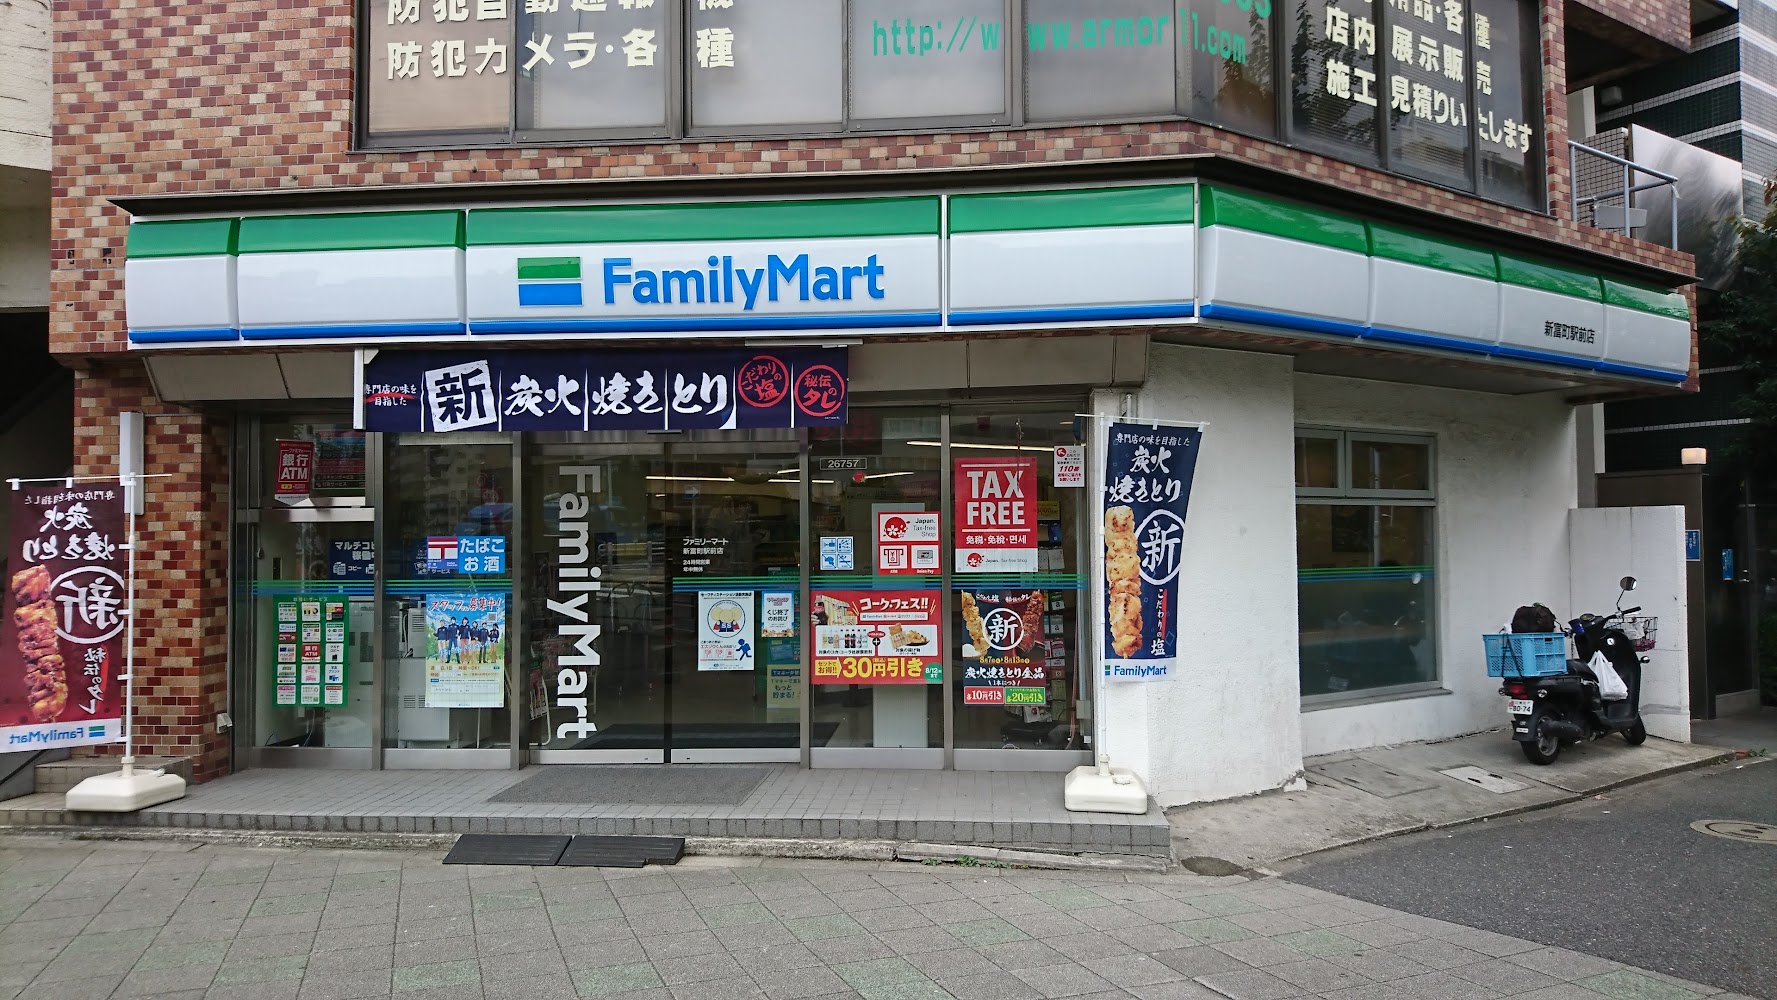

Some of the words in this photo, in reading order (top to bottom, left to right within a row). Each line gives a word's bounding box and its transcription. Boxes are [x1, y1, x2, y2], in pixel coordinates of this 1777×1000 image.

[1325, 7, 1491, 95] 店内展示販売
[603, 254, 884, 310] FamilyMart
[1544, 320, 1595, 344] 新富町駅前店
[374, 396, 407, 406] 目指した
[435, 367, 488, 424] 新
[1115, 432, 1191, 447] 専門店の味を目指した
[282, 453, 309, 466] 銀行
[827, 460, 859, 468] 26757
[1130, 445, 1172, 474] 炭火
[281, 467, 308, 480] ATM
[967, 471, 1024, 498] TAX
[1109, 474, 1182, 503] 焼きとり
[967, 501, 1025, 525] FREE
[460, 538, 505, 553] たばこ
[682, 538, 729, 546] ファミリーマート
[682, 547, 724, 555] 新富町駅前店
[1140, 519, 1181, 574] 新
[463, 556, 500, 572] お酒
[547, 466, 601, 739] FamilyMart
[988, 613, 1019, 644] 新
[965, 666, 1045, 679] 炭火焼きとり全品
[1114, 665, 1167, 677] FamilyMart
